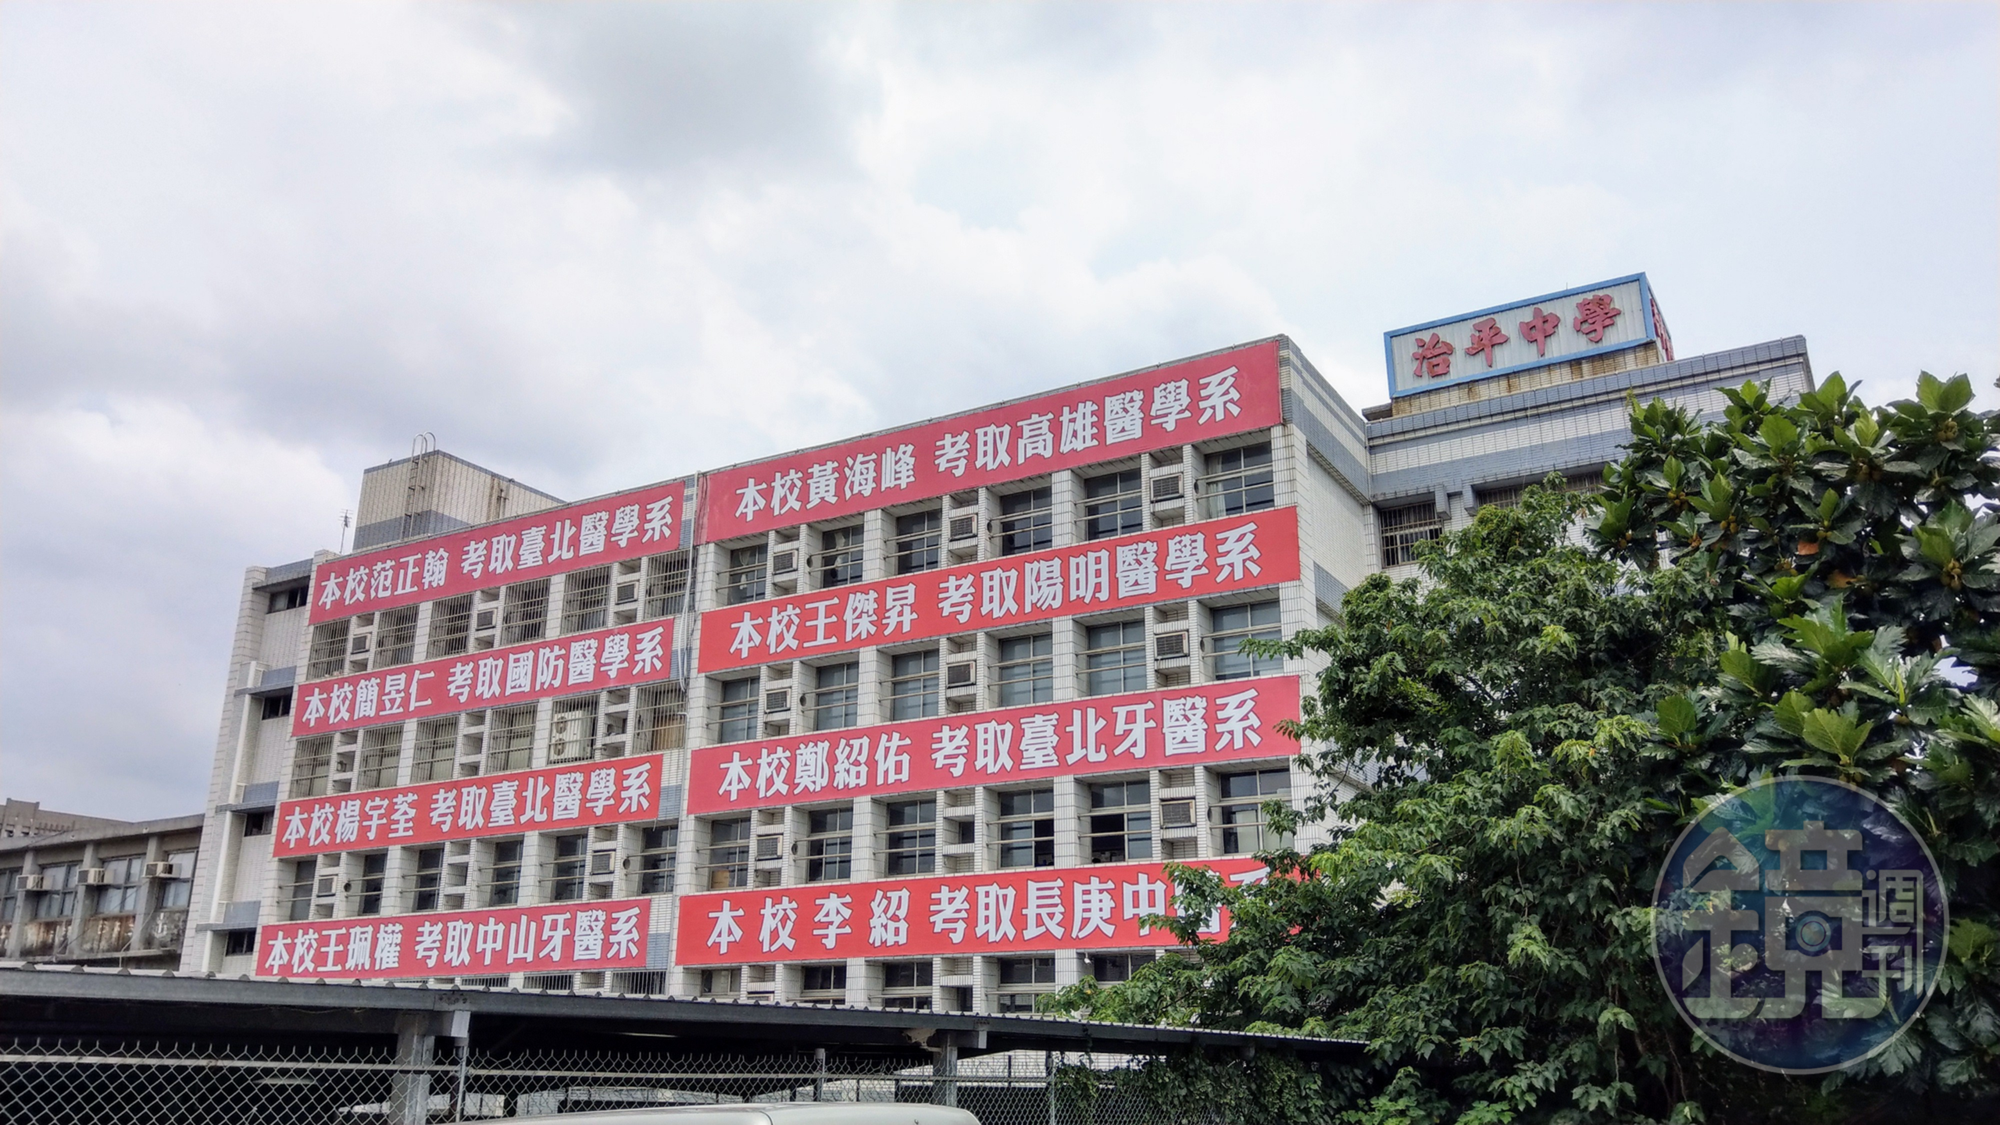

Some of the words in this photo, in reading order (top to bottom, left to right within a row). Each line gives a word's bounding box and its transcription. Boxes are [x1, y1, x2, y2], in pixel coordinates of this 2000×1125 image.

[1411, 293, 1622, 378] 治平中學
[734, 442, 917, 522] 本校黃海峰
[933, 365, 1242, 478] 考取高雄醫學系
[317, 546, 450, 610] 本校范正翰
[460, 494, 675, 580] 考取臺北醫學系
[728, 581, 919, 659] 本校王傑昇
[937, 521, 1262, 625] 考取陽明醫學系
[301, 669, 436, 728] 本校簡昱仁
[446, 625, 665, 704] 考取國防醫學系
[718, 731, 912, 802] 本校鄭紹佑
[931, 688, 1263, 778] 考取臺北牙醫系
[281, 792, 419, 849] 本校楊宇荃
[428, 762, 652, 833] 考取臺北醫學系
[264, 921, 405, 974] 本校王珮權
[414, 905, 641, 968] 考取中山牙醫系
